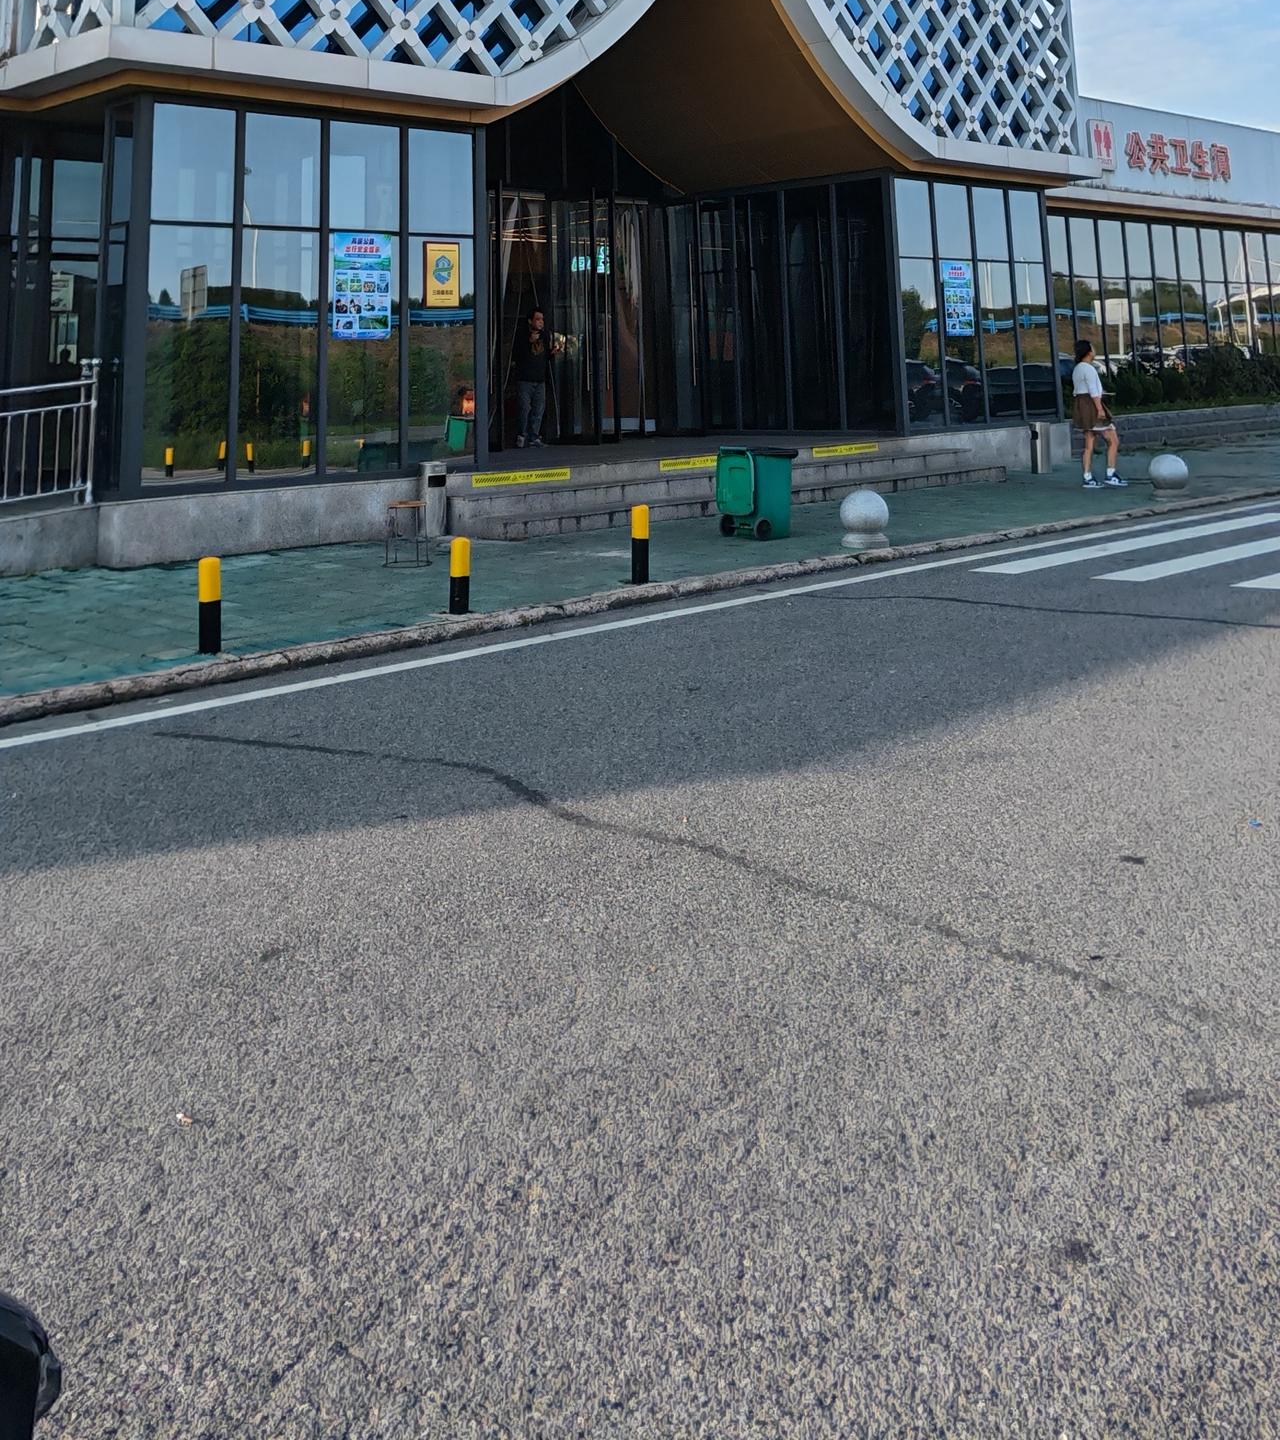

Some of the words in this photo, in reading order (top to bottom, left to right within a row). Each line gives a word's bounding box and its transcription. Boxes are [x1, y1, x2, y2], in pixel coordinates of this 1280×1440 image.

[1125, 131, 1231, 183] 公共卫生间
